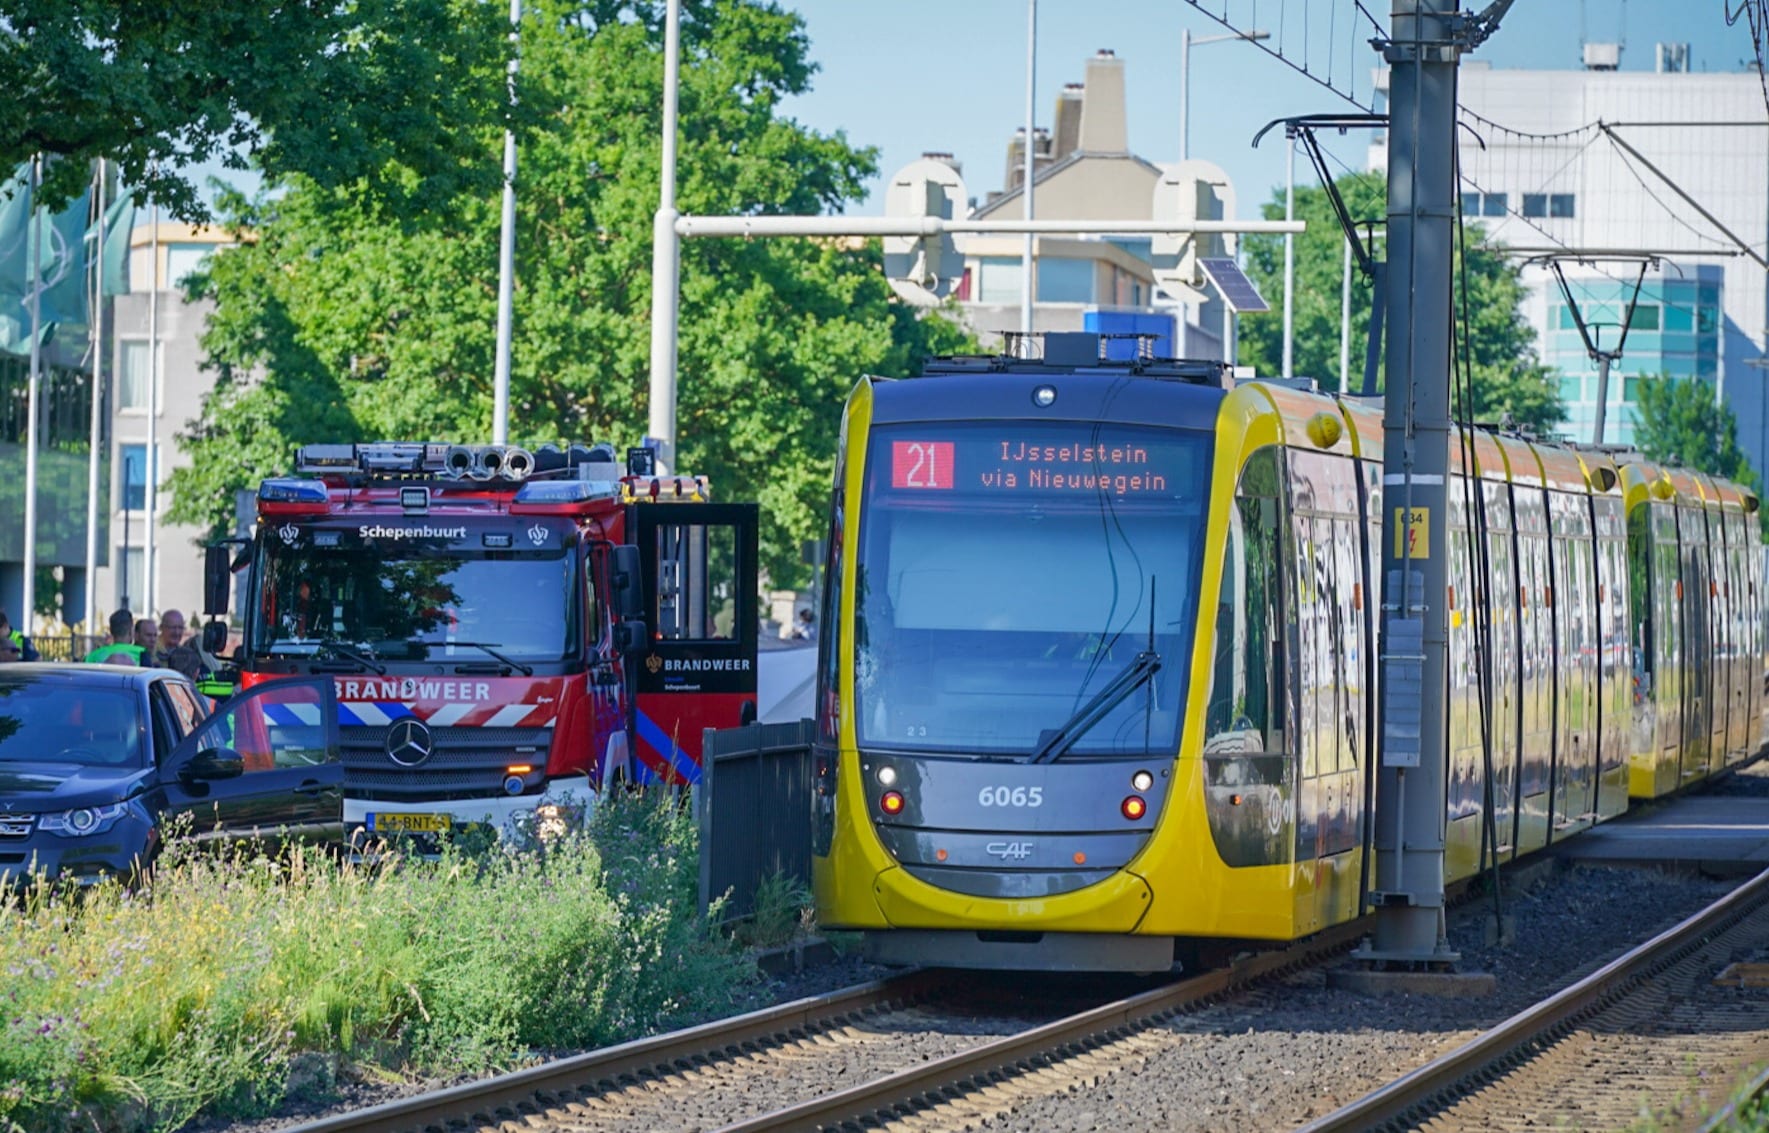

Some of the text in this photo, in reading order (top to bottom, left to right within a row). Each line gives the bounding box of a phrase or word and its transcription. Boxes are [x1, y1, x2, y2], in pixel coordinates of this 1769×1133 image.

[1000, 441, 1148, 464] IJsselstein
[906, 443, 937, 488] 21
[980, 468, 1166, 494] via Nieuwegein
[359, 525, 467, 540] Schepenbuurt
[664, 659, 751, 671] BRANDWEER
[334, 679, 491, 700] BRANDWEER
[907, 726, 927, 737] 2 3
[978, 785, 1044, 808] 6065
[986, 842, 1033, 859] CAF
